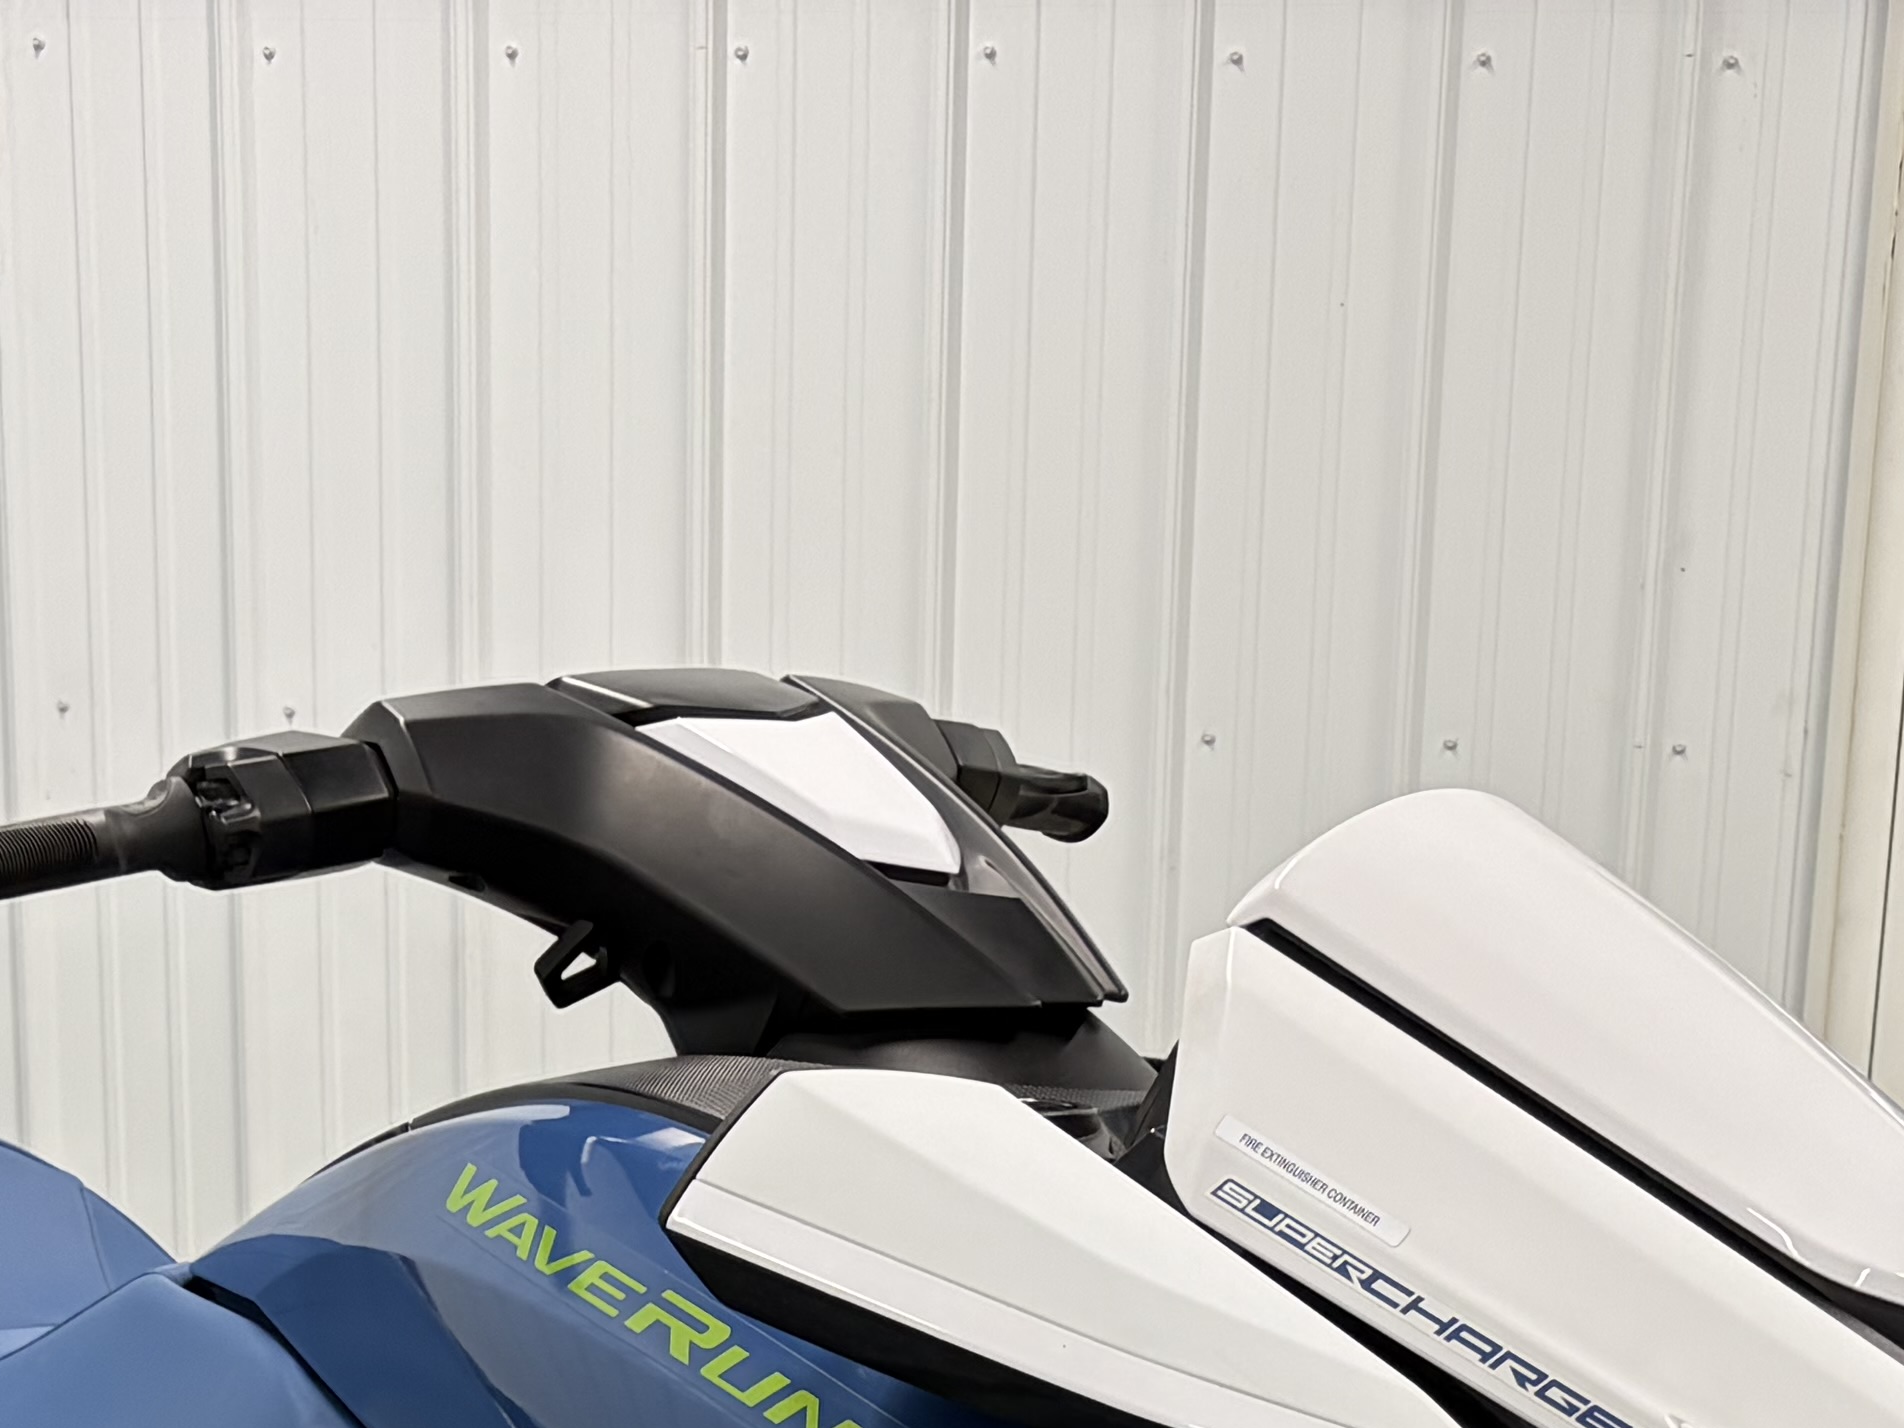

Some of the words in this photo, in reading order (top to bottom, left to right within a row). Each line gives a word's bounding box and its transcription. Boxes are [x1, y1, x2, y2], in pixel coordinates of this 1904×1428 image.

[1239, 1132, 1263, 1153] FIRE
[1261, 1146, 1328, 1195] EXTINGUISHER
[1326, 1187, 1380, 1227] CONTAINER
